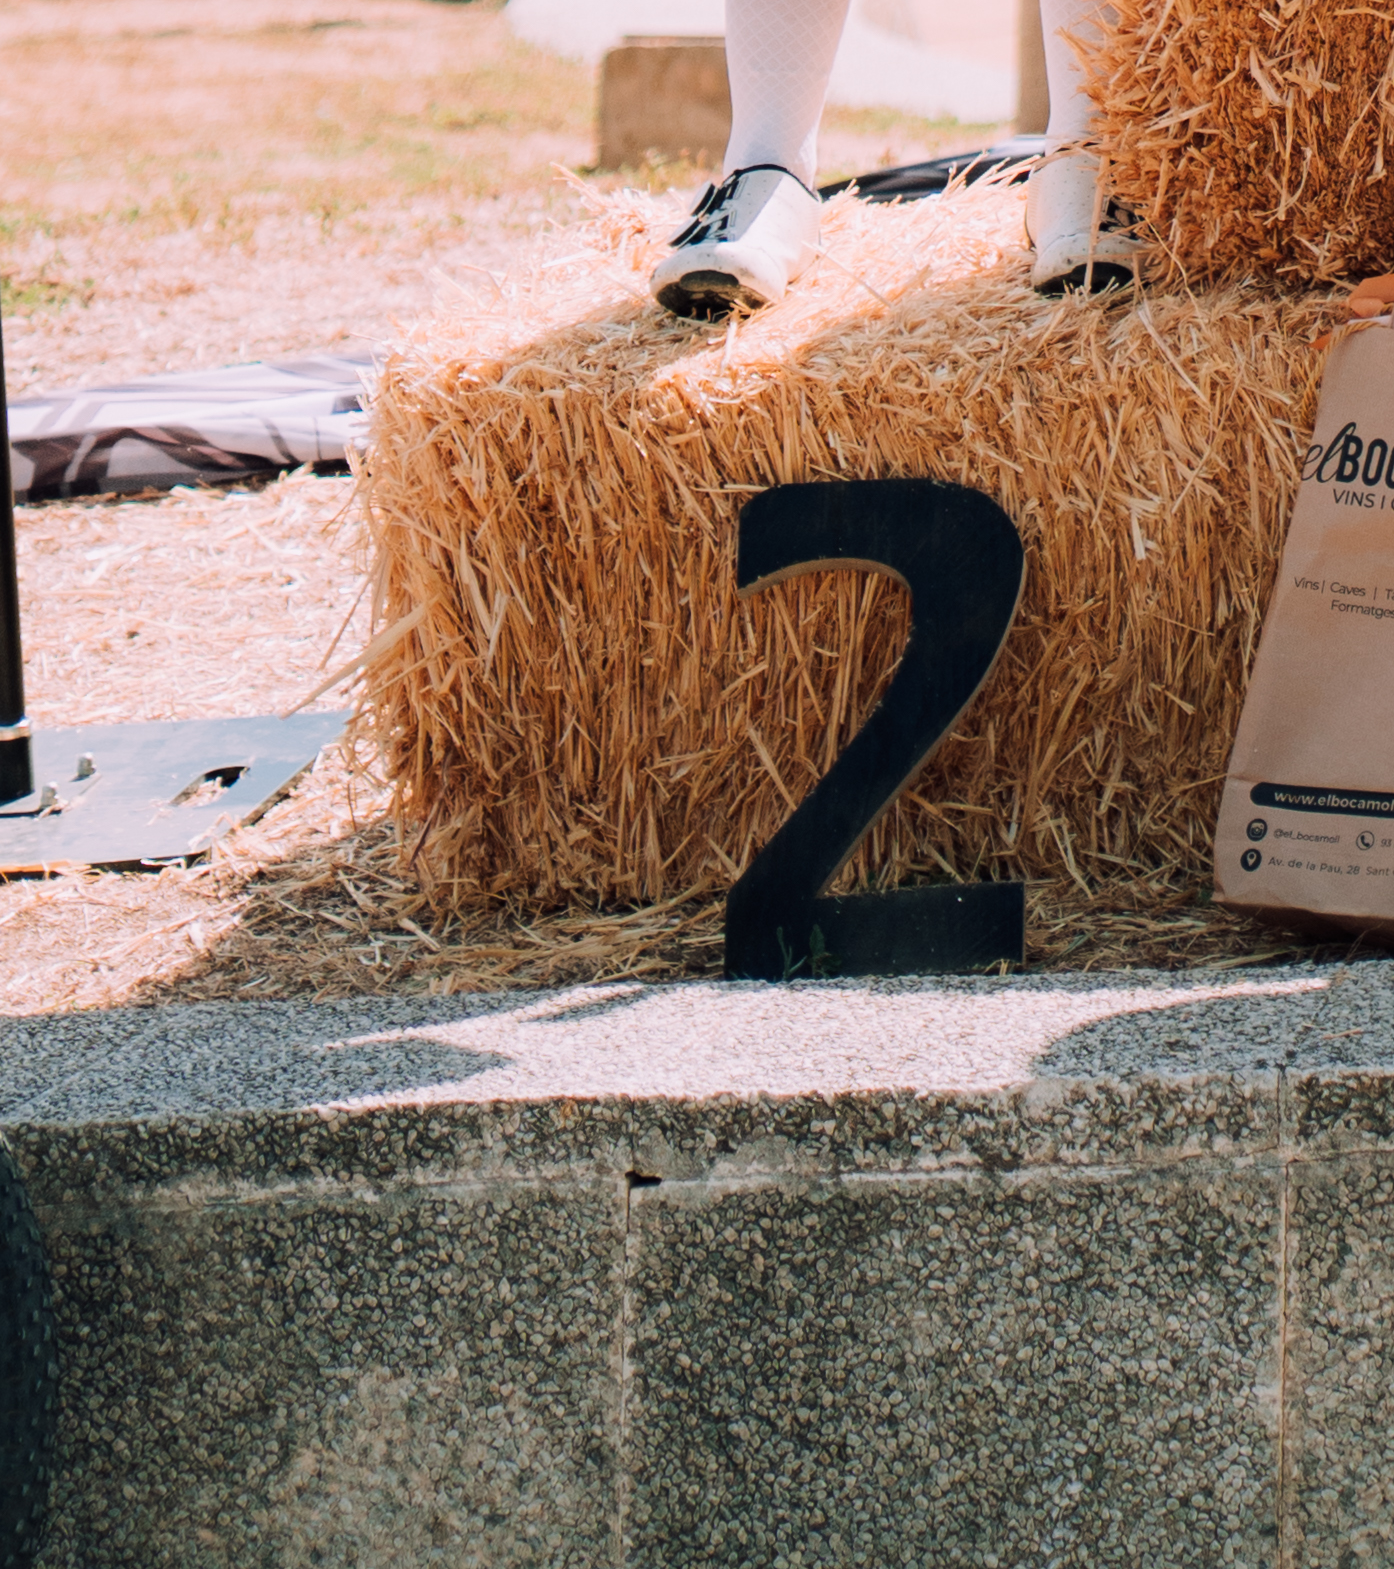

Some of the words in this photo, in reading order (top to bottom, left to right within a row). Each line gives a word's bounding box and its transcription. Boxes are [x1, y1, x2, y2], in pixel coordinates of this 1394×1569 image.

[1333, 488, 1376, 510] VINS
[1330, 581, 1366, 597] Caves
[725, 478, 1026, 980] 2
[1268, 856, 1285, 867] Av.
[1288, 858, 1303, 870] de
[1306, 860, 1316, 872] la
[1319, 863, 1343, 876] Pau,
[1346, 864, 1361, 876] 28
[1366, 866, 1390, 877] Sant
